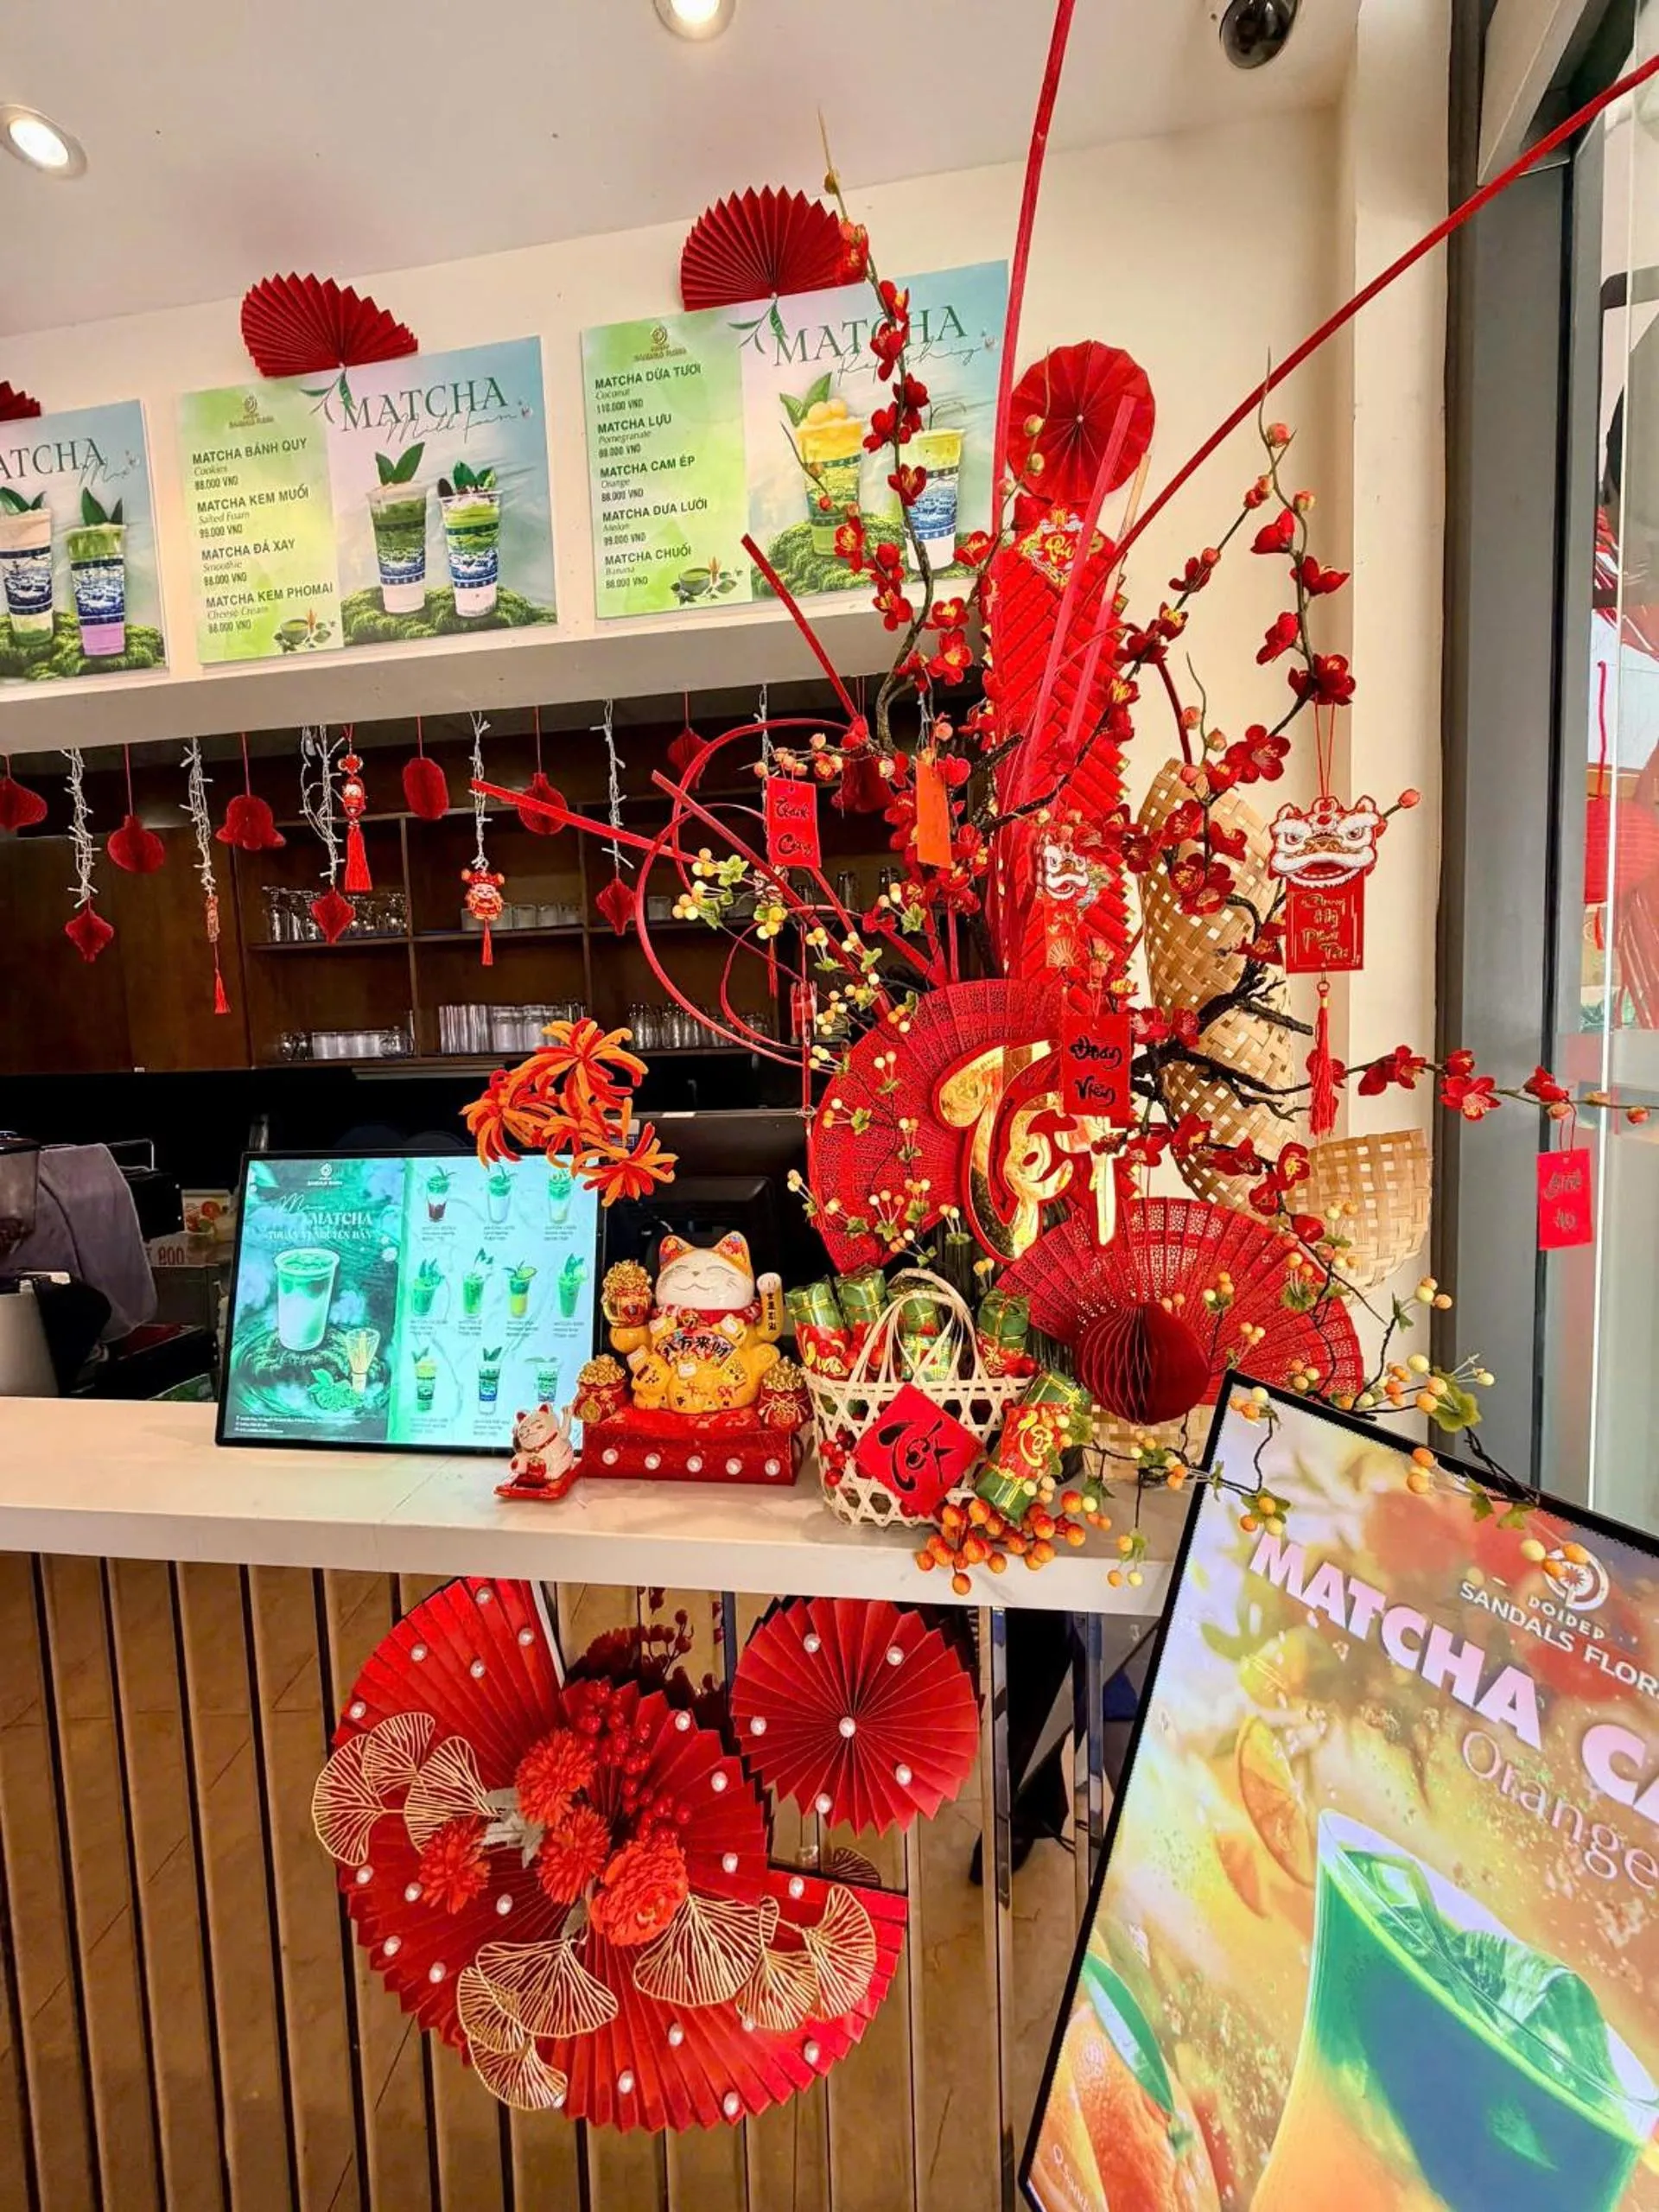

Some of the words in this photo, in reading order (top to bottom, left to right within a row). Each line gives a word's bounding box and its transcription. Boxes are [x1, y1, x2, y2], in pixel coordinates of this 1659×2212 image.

[594, 372, 643, 390] MATCHA
[341, 377, 508, 431] MATCHA
[597, 417, 645, 434] MATCHA
[648, 413, 672, 428] LỰU
[193, 448, 242, 465] MATCHA
[245, 442, 278, 458] BÁNH
[282, 438, 307, 451] QUY
[600, 463, 648, 479] MATCHA
[651, 459, 677, 472] CAM
[679, 454, 696, 467] ÉP
[197, 497, 246, 513] MATCHA
[250, 492, 276, 505] KEM
[278, 483, 309, 501] MUỐI
[602, 507, 650, 522] MATCHA
[681, 497, 708, 512] LƯỚI
[201, 545, 251, 561] MATCHA
[253, 539, 270, 554] ĐÁ
[273, 538, 296, 551] XAY
[605, 551, 652, 566] MATCHA
[655, 543, 691, 560] CHUỐI
[206, 594, 254, 607] MATCHA
[257, 589, 283, 602] KEM
[287, 582, 334, 599] PHOMAI
[1459, 1581, 1575, 1652] SANDALS
[1583, 1643, 1659, 1700] FLOR
[1249, 1532, 1543, 1752] MATCHA
[1582, 1723, 1659, 1824] C
[1462, 1730, 1659, 1890] Orange
